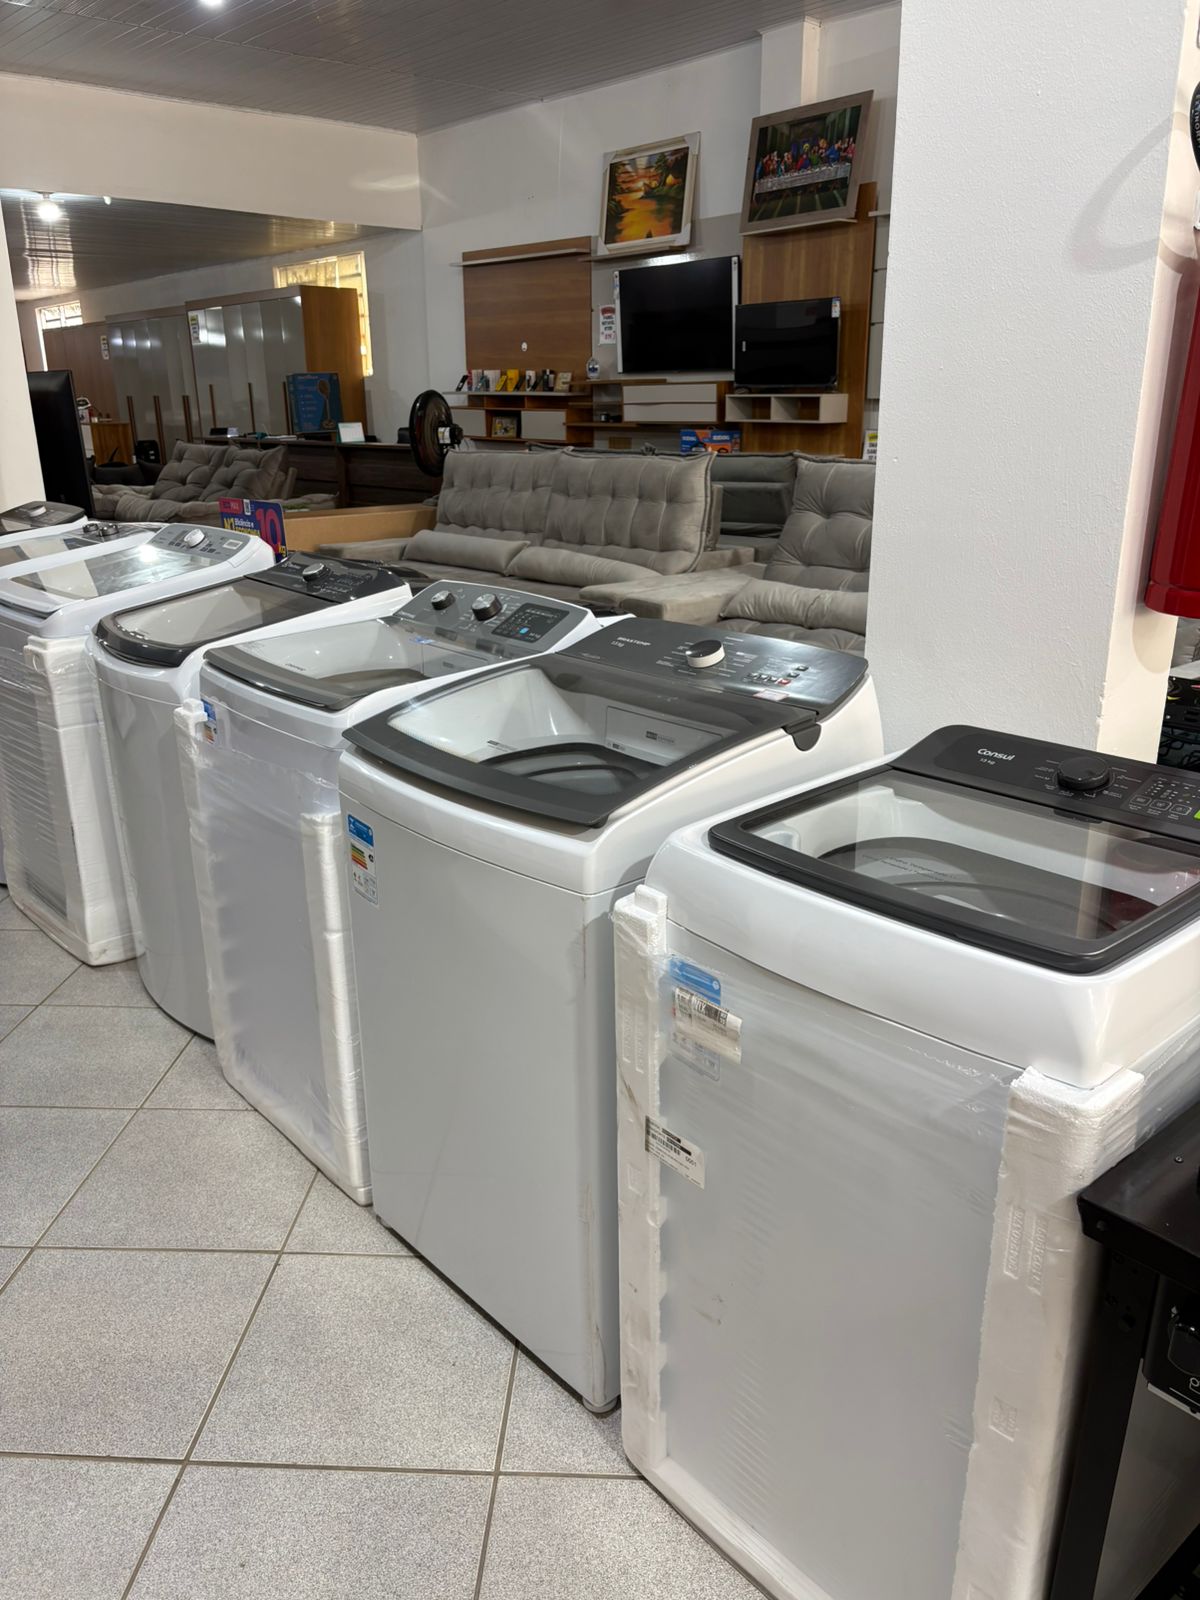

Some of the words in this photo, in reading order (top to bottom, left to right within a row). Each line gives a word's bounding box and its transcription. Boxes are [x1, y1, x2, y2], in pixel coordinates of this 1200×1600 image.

[256, 508, 281, 553] 10
[617, 636, 652, 646] BRASTEMP
[977, 748, 1016, 761] Consul
